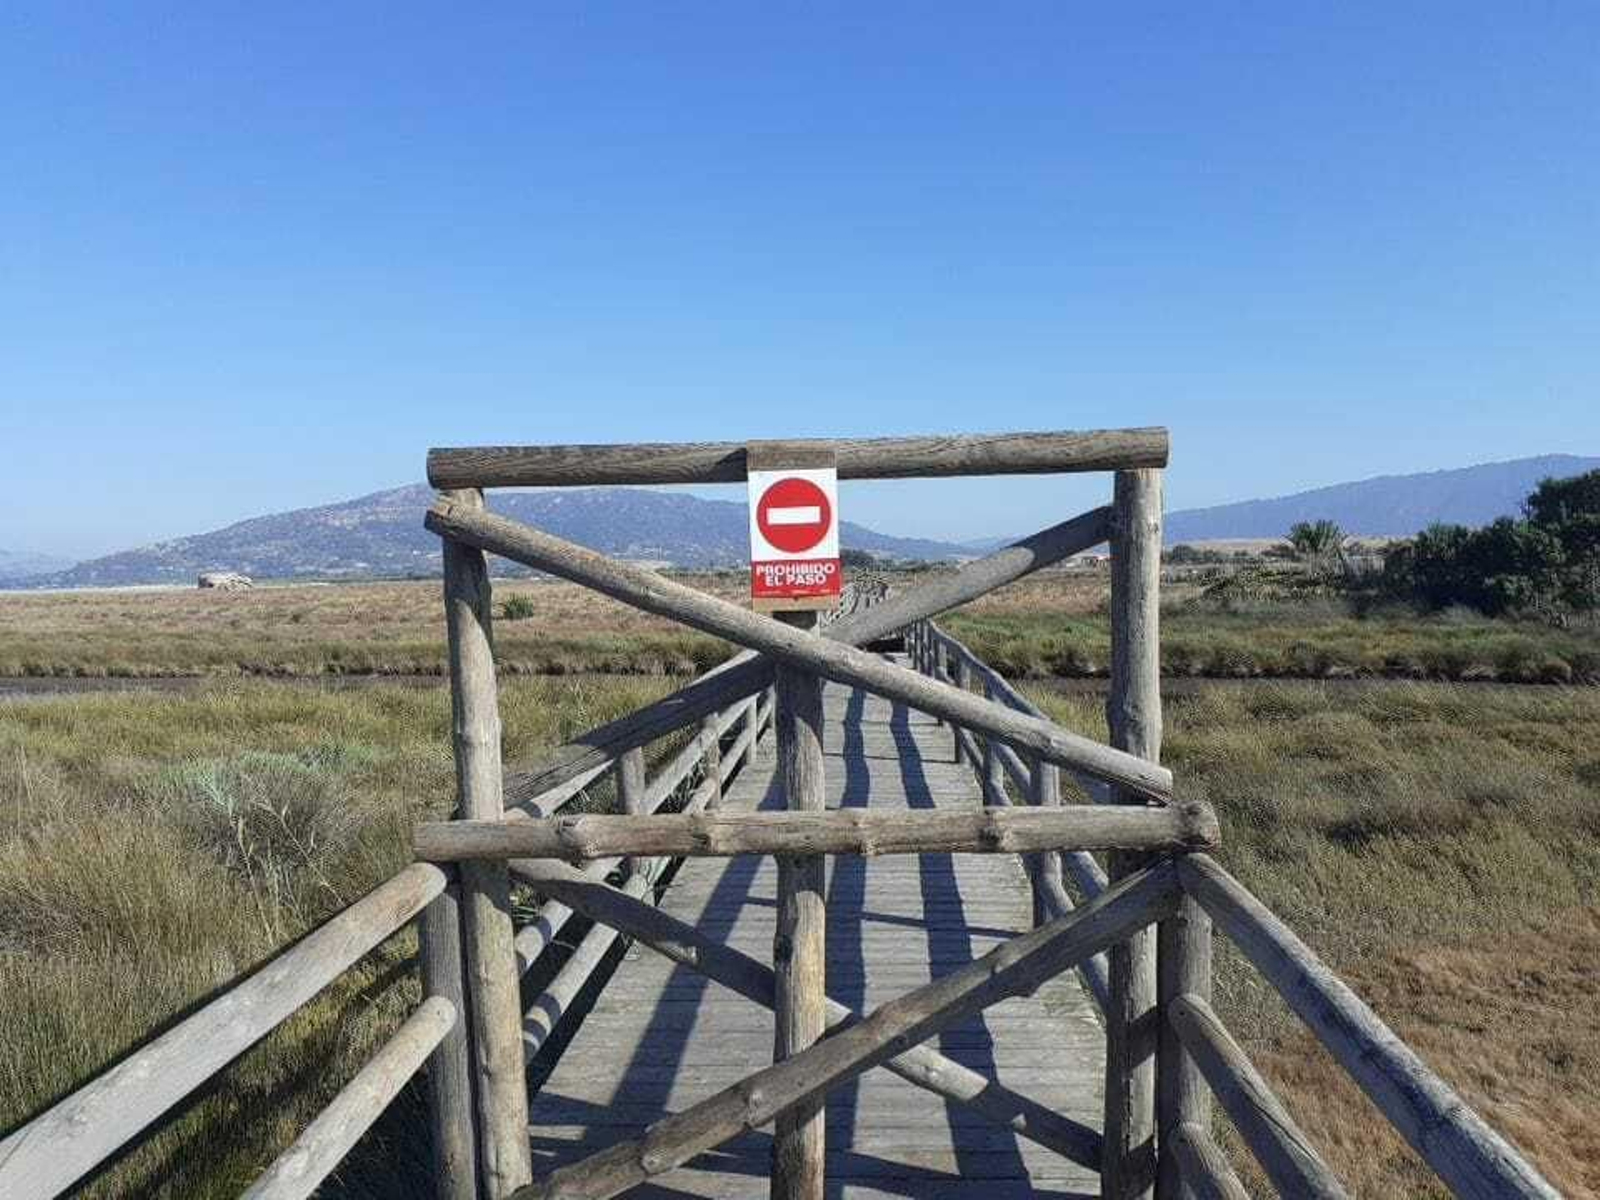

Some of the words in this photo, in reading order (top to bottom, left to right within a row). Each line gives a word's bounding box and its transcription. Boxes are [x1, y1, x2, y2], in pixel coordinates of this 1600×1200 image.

[756, 563, 836, 576] PROHIBIDO
[765, 575, 783, 587] EL
[786, 573, 827, 586] PASO
